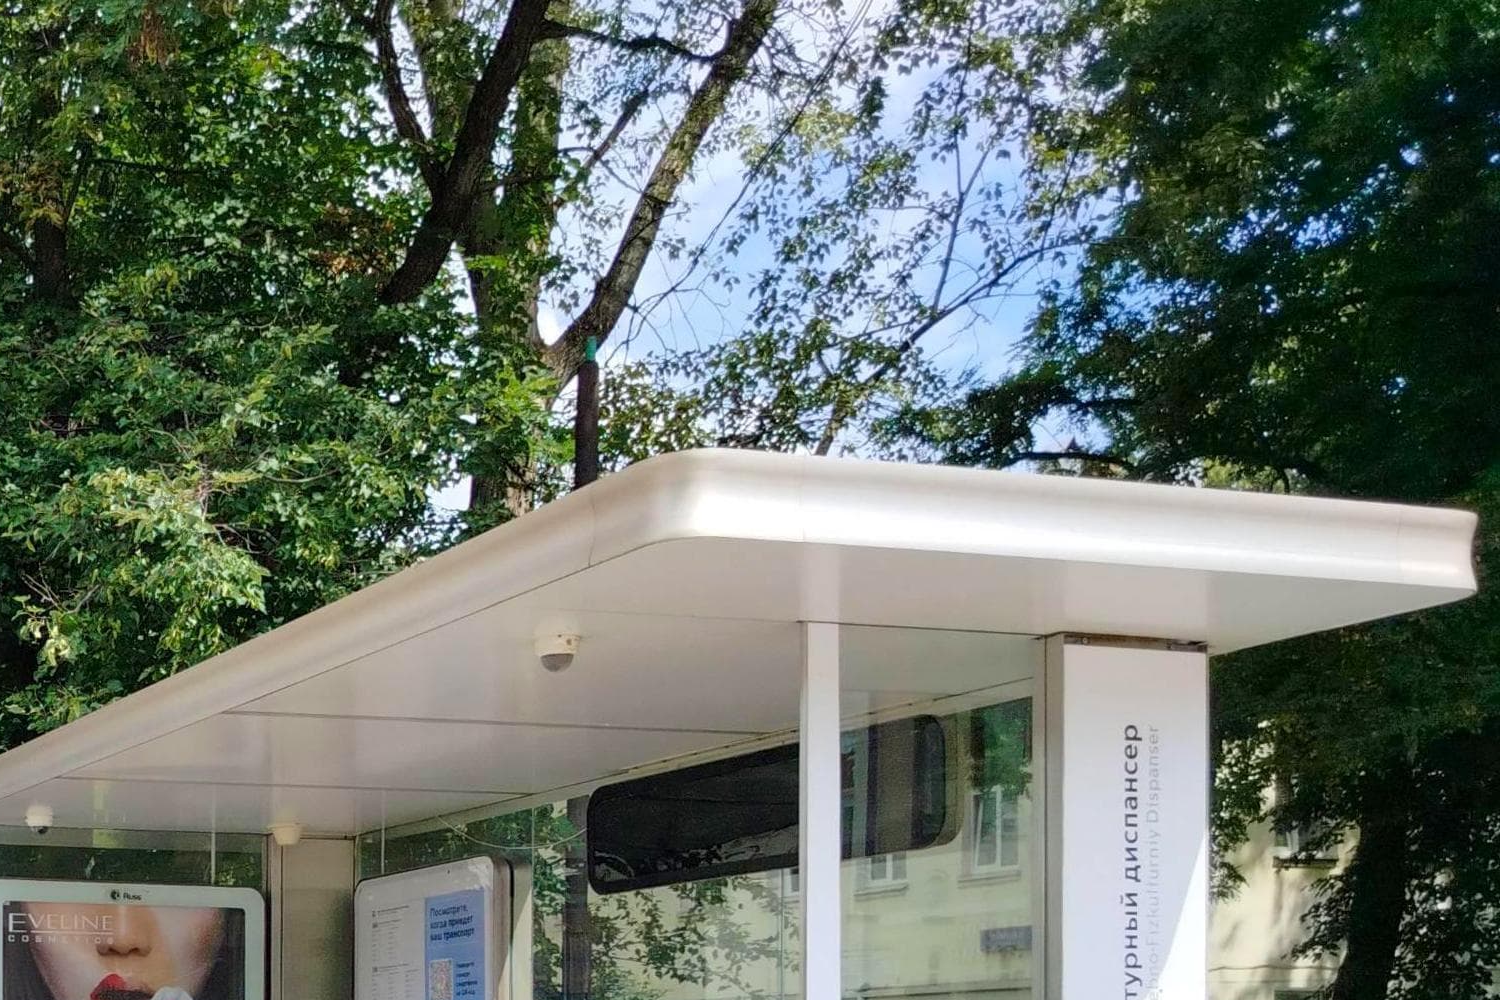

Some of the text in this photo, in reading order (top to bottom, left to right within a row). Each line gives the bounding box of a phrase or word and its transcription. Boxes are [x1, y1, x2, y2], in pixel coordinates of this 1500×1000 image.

[1124, 724, 1143, 883] диспансер
[1146, 725, 1162, 824] Dispanser
[8, 913, 114, 933] EVELINE
